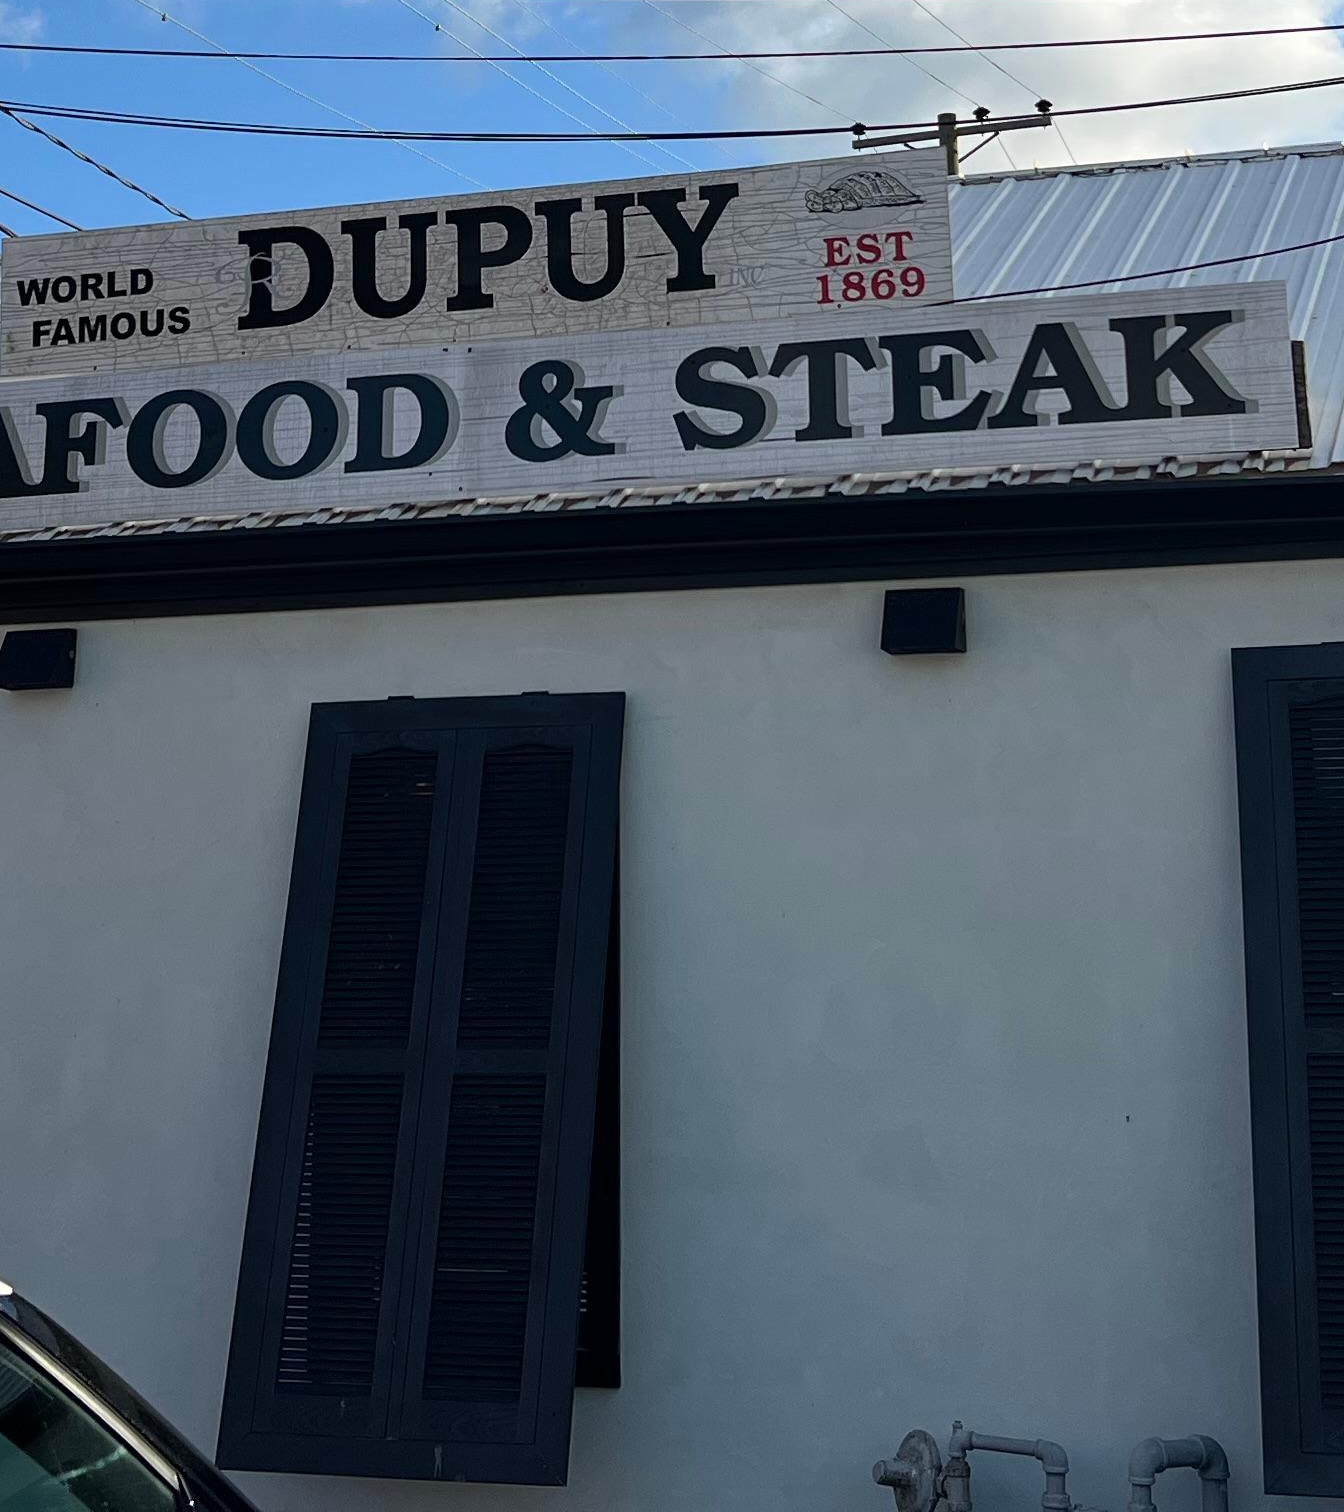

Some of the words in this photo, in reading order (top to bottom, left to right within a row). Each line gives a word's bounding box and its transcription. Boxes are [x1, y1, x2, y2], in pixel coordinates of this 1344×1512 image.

[237, 182, 739, 331] DUPUY
[823, 231, 913, 267] EST
[17, 268, 154, 306] WORLD
[816, 267, 926, 304] 1869
[33, 306, 191, 347] FAMOUS
[505, 359, 620, 463] &
[672, 309, 1250, 451] STEAK
